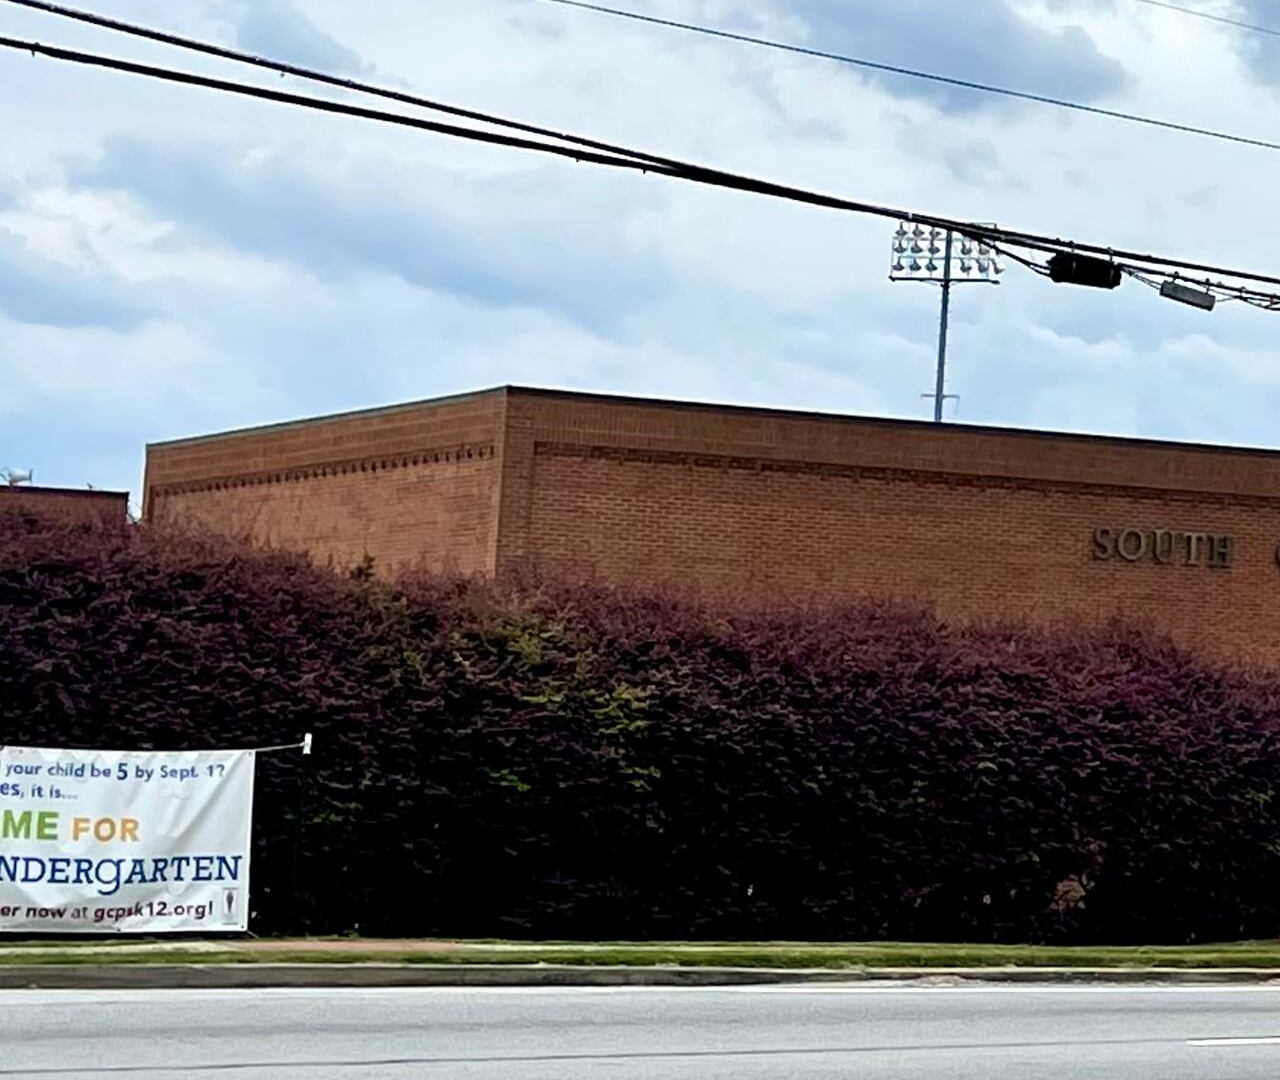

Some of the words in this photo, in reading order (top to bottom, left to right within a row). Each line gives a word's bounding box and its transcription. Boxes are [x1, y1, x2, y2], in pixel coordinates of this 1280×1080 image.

[1093, 528, 1231, 568] SOUTH
[5, 763, 42, 777] your
[47, 762, 86, 778] child
[90, 762, 111, 778] be
[116, 762, 128, 781] 5
[135, 765, 154, 782] by
[160, 764, 199, 782] Sept.
[31, 783, 44, 798] it
[2, 809, 59, 840] ME
[72, 816, 140, 842] FOR
[0, 905, 21, 917] er
[25, 906, 68, 919] now
[71, 905, 90, 919] at
